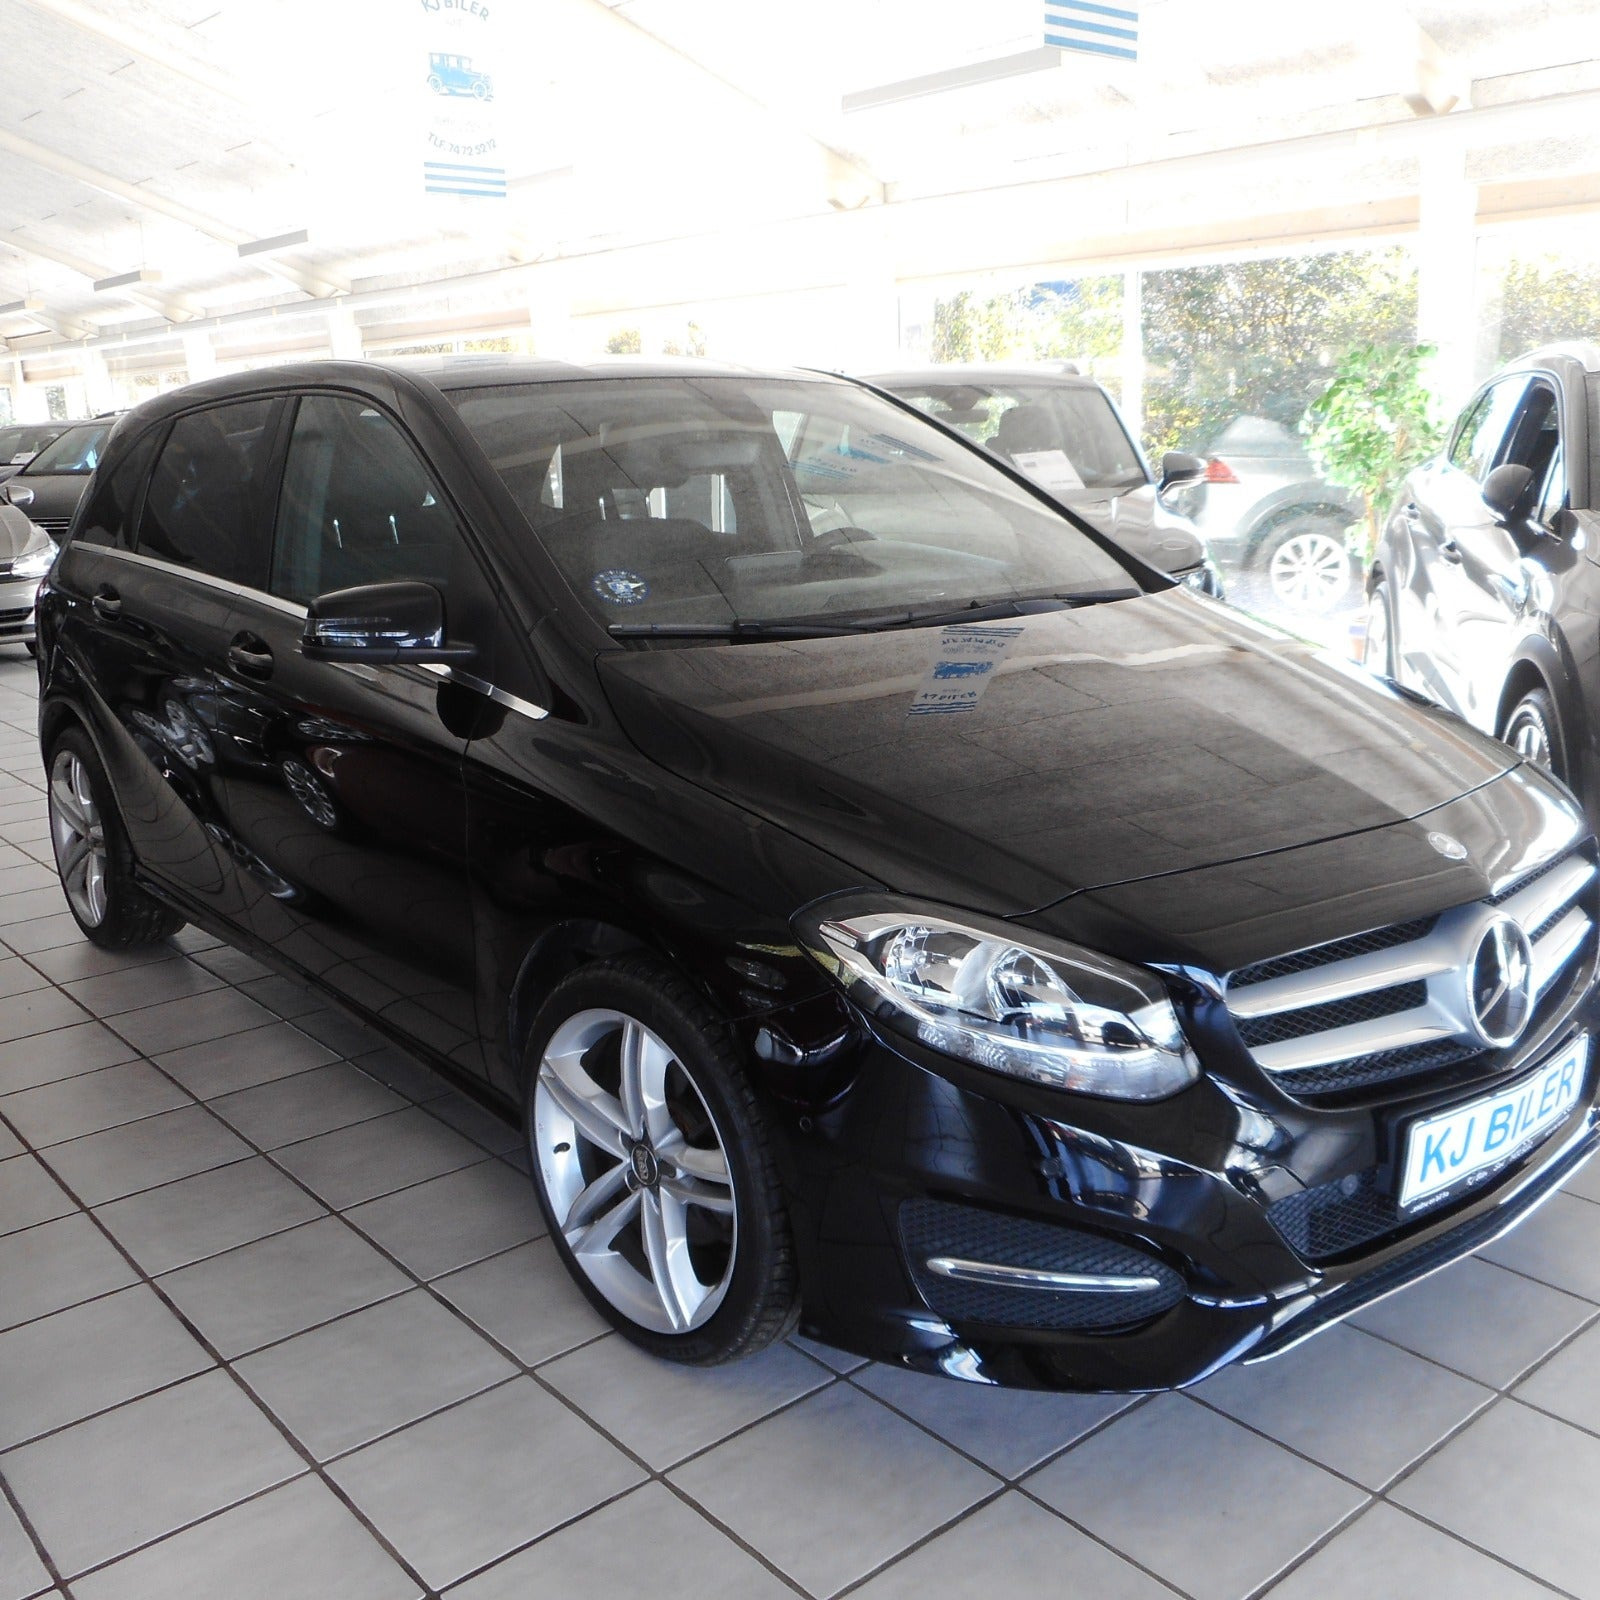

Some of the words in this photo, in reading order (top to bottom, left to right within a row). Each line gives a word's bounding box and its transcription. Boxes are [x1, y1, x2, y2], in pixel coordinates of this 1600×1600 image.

[444, 0, 489, 21] BILER
[1419, 1116, 1476, 1183] KJ
[1484, 1056, 1576, 1153] BILER
